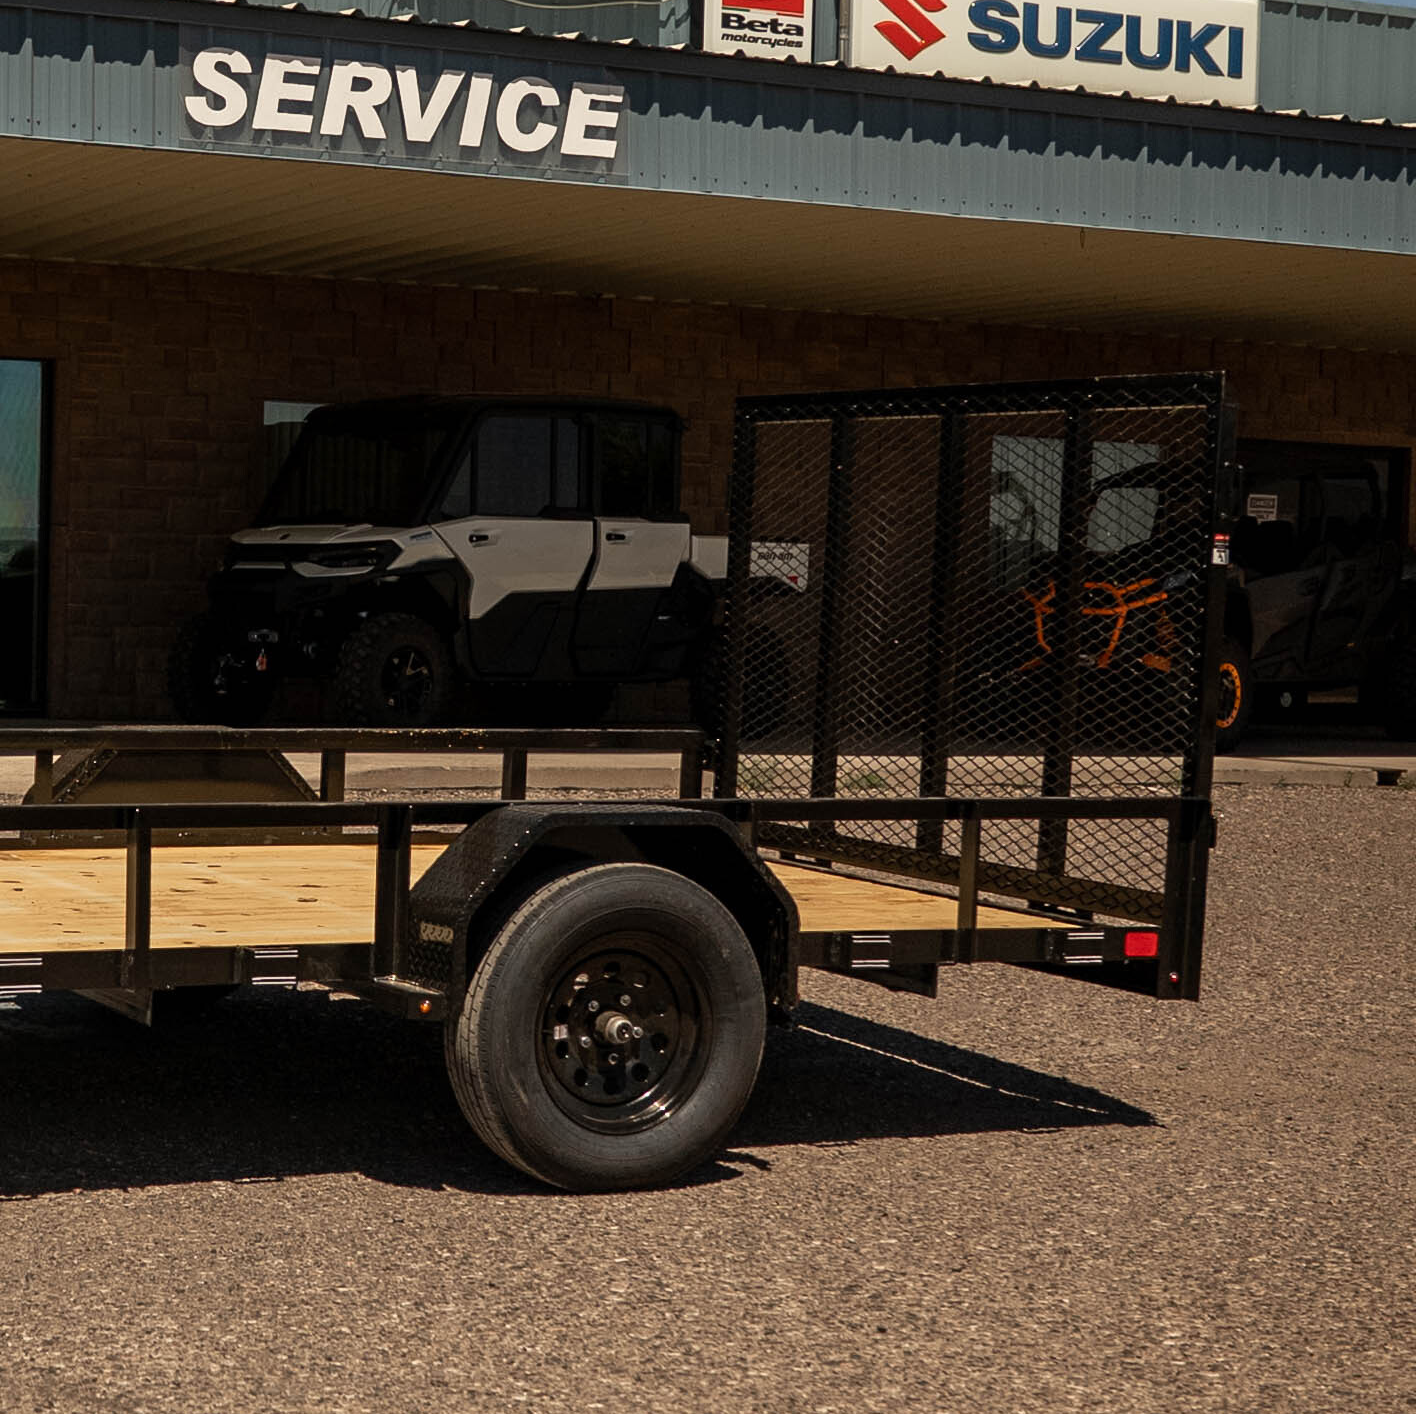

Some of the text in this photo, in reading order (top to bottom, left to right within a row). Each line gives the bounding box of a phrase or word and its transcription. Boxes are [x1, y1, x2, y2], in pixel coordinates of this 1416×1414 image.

[721, 13, 804, 37] Beta
[721, 34, 803, 48] motorcycles
[184, 49, 625, 159] SERVICE
